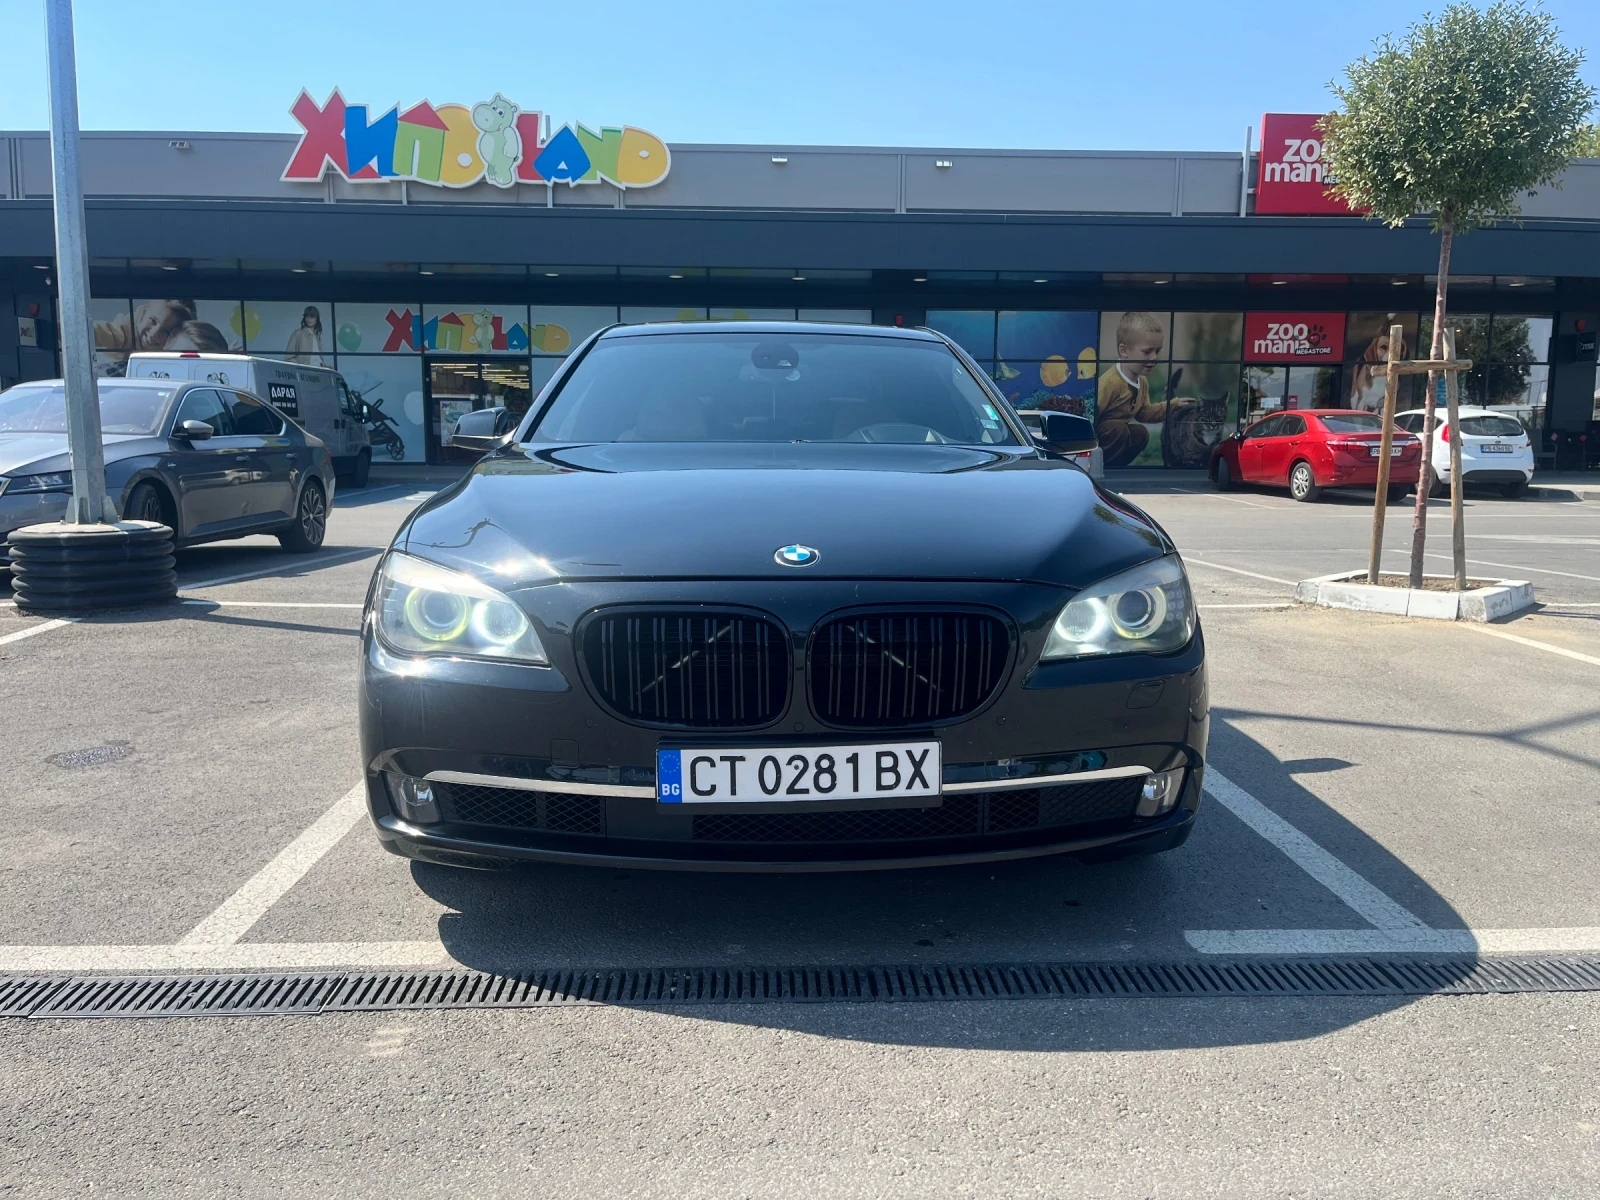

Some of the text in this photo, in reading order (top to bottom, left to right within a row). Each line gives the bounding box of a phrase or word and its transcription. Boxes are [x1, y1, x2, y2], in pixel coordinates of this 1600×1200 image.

[1295, 347, 1332, 355] MEGASTORE
[689, 748, 931, 797] CT 0281 BX
[661, 783, 680, 796] BG
